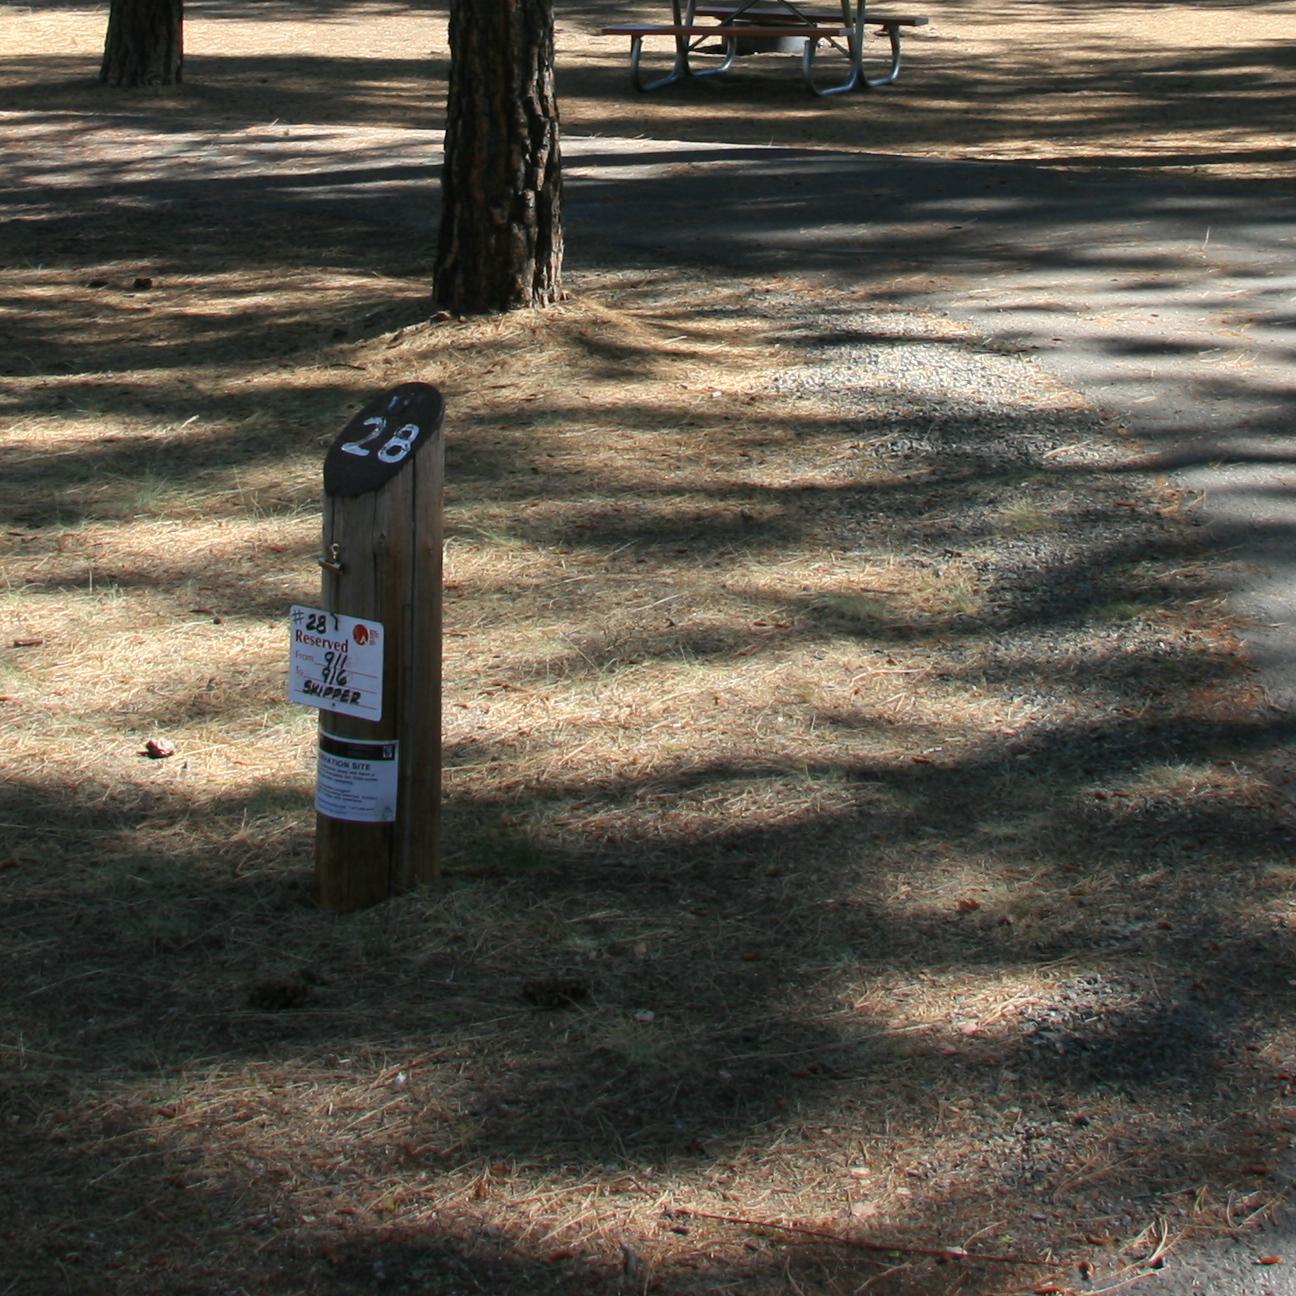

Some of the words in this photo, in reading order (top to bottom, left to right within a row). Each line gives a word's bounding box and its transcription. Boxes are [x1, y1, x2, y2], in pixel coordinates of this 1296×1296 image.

[341, 416, 420, 464] 28
[295, 629, 349, 653] Reserved
[303, 680, 361, 704] SKIPPER
